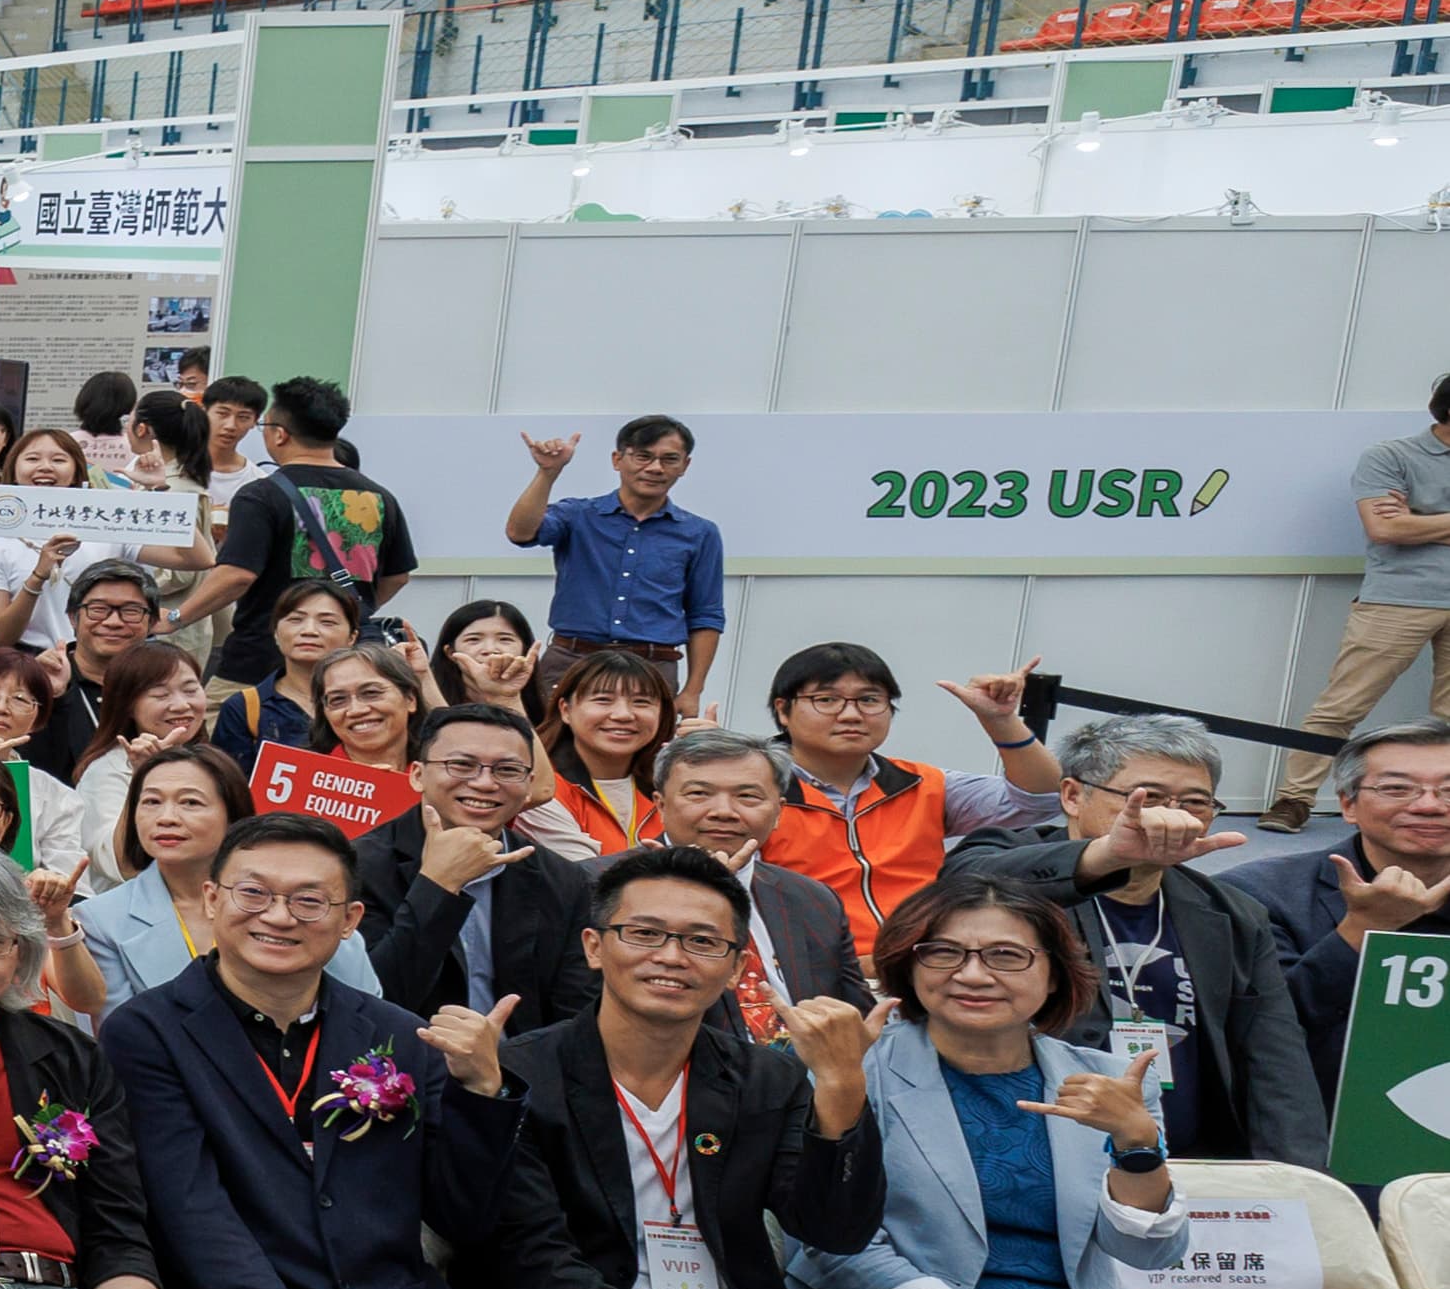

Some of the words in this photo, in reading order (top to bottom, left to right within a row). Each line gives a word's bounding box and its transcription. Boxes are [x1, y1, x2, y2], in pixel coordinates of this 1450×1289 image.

[36, 187, 227, 237] 國立臺灣師範大
[864, 468, 1030, 520] 2023
[1047, 468, 1184, 520] USR
[266, 762, 297, 803] 5
[312, 771, 376, 800] GENDER
[304, 794, 381, 825] EQUALITY
[1174, 958, 1196, 1026] USR
[1381, 955, 1448, 1008] 13
[662, 1259, 701, 1274] VVIP
[1149, 1273, 1166, 1285] VIP
[1171, 1273, 1222, 1284] reserved
[1229, 1273, 1267, 1285] seats
